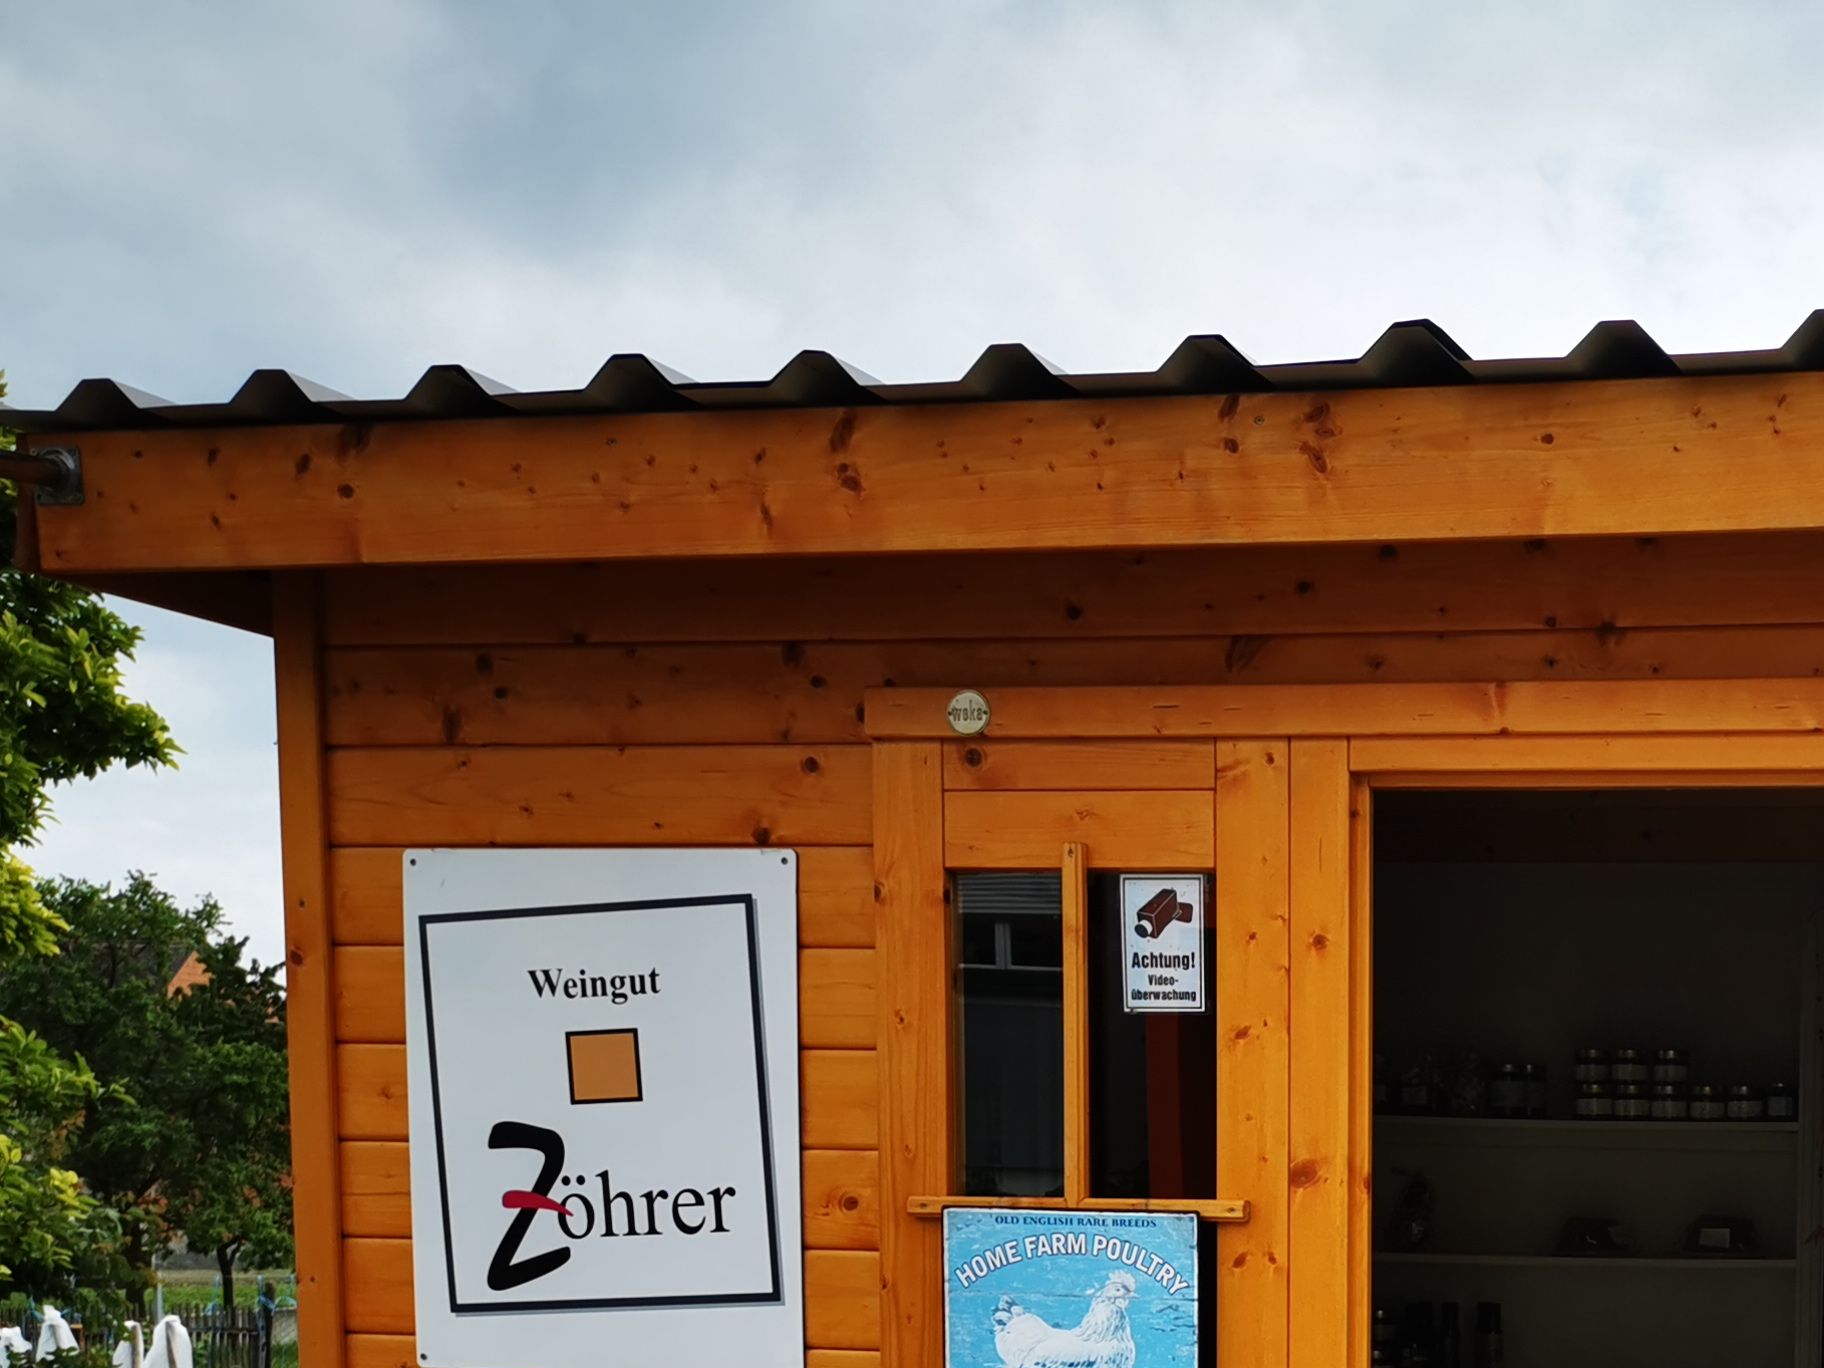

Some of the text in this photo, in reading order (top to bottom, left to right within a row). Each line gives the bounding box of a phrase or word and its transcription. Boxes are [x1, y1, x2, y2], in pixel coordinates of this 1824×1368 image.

[1131, 951, 1196, 971] Achtung!
[528, 967, 661, 1004] Weingut
[1148, 974, 1179, 986] Video-
[1131, 988, 1197, 1003] überwachung
[487, 1121, 736, 1291] Zöhrer
[995, 1215, 1157, 1229] OLD ENGLISH RARE BREEDS
[954, 1232, 1189, 1296] HOME FARM POULTRY
